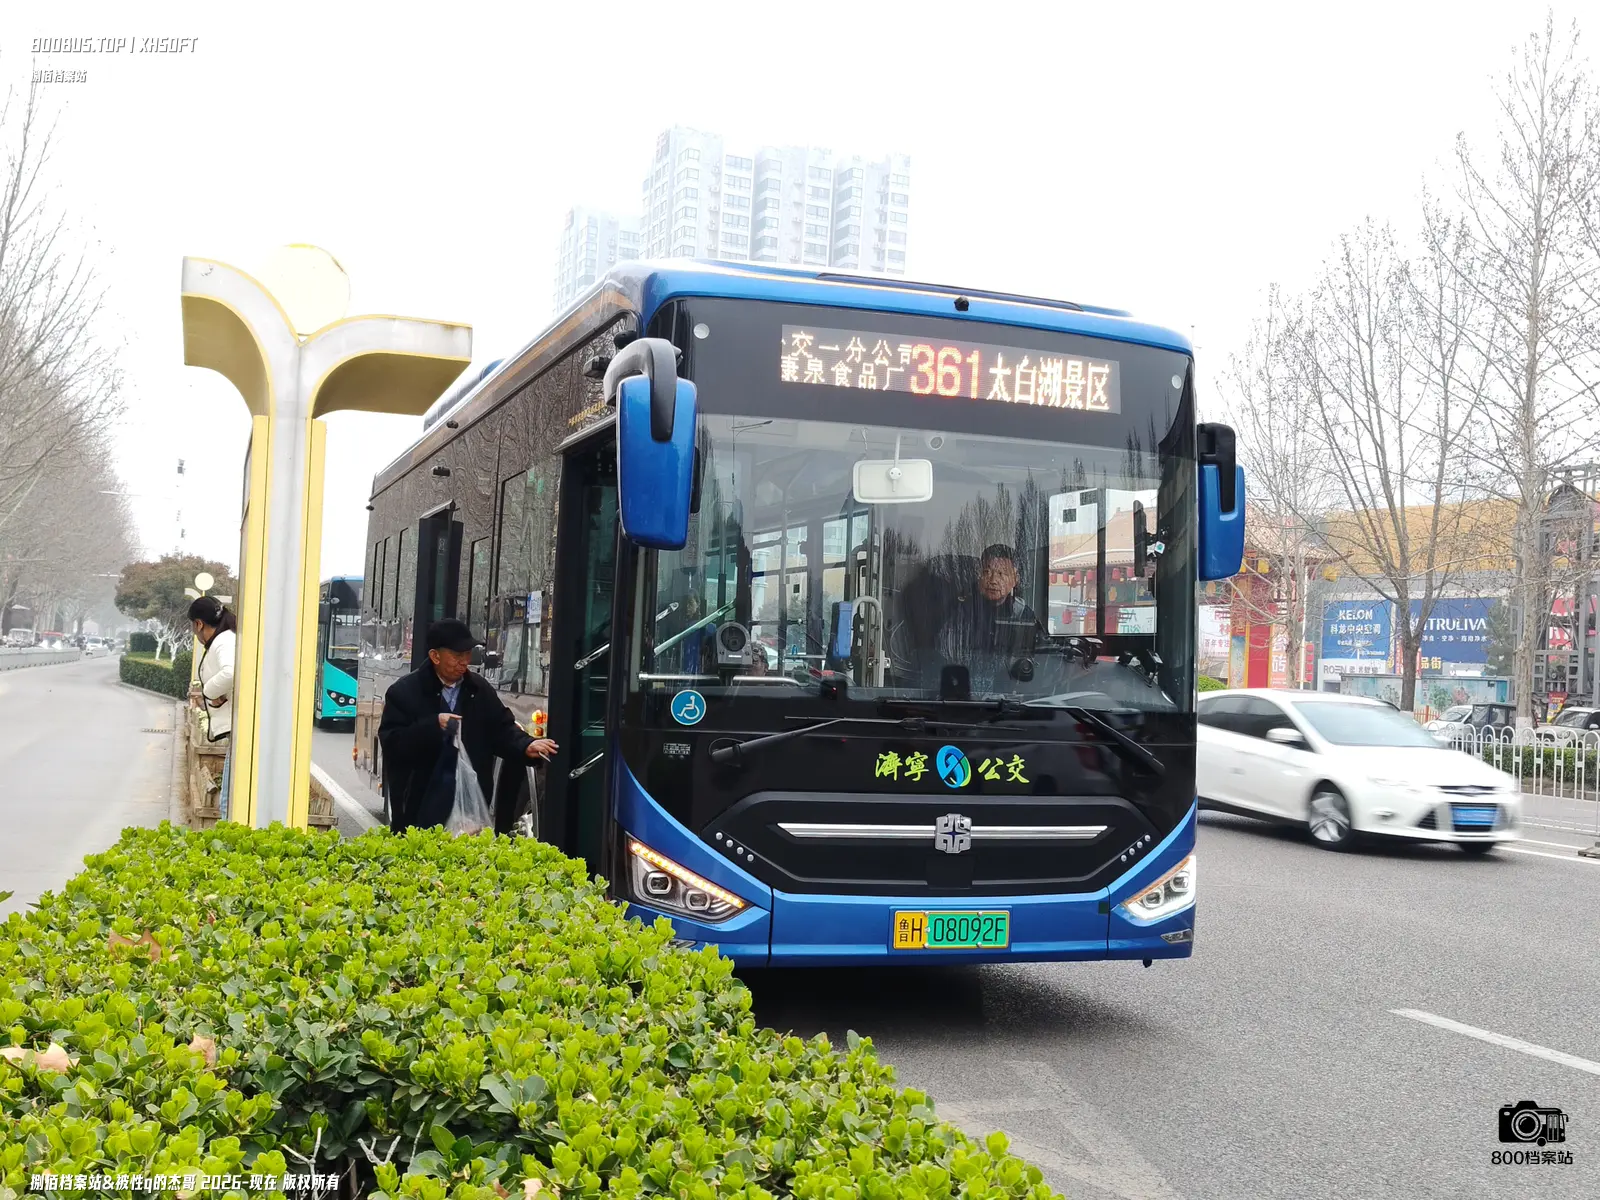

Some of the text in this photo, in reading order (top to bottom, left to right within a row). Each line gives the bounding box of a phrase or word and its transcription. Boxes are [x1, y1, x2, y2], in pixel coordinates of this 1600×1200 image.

[781, 330, 912, 364] 交一分公司
[910, 344, 981, 399] 361
[986, 352, 1110, 411] 太白湖景区
[1339, 609, 1374, 620] KELON
[978, 754, 1030, 784] 公交
